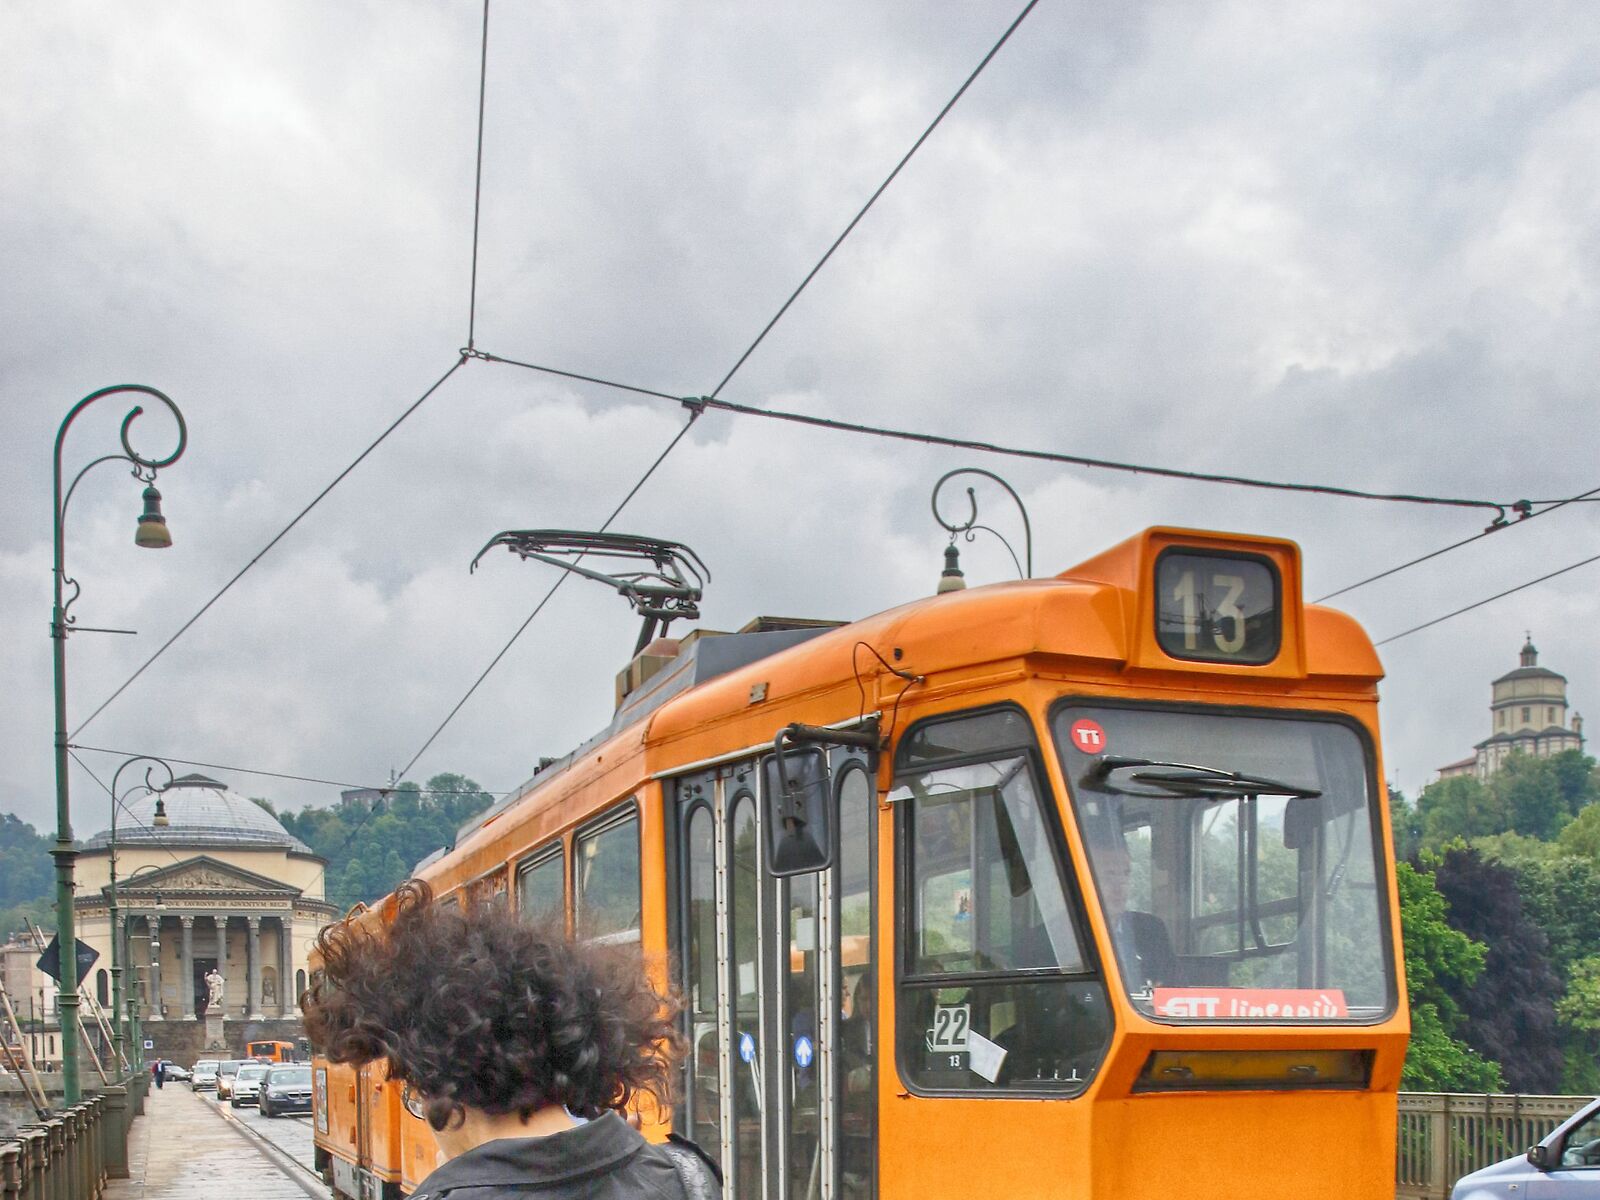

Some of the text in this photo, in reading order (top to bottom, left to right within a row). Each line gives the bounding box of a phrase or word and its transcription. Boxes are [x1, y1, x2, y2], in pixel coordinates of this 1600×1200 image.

[1174, 570, 1246, 654] 13
[935, 1008, 968, 1046] 22
[949, 1055, 960, 1067] 13
